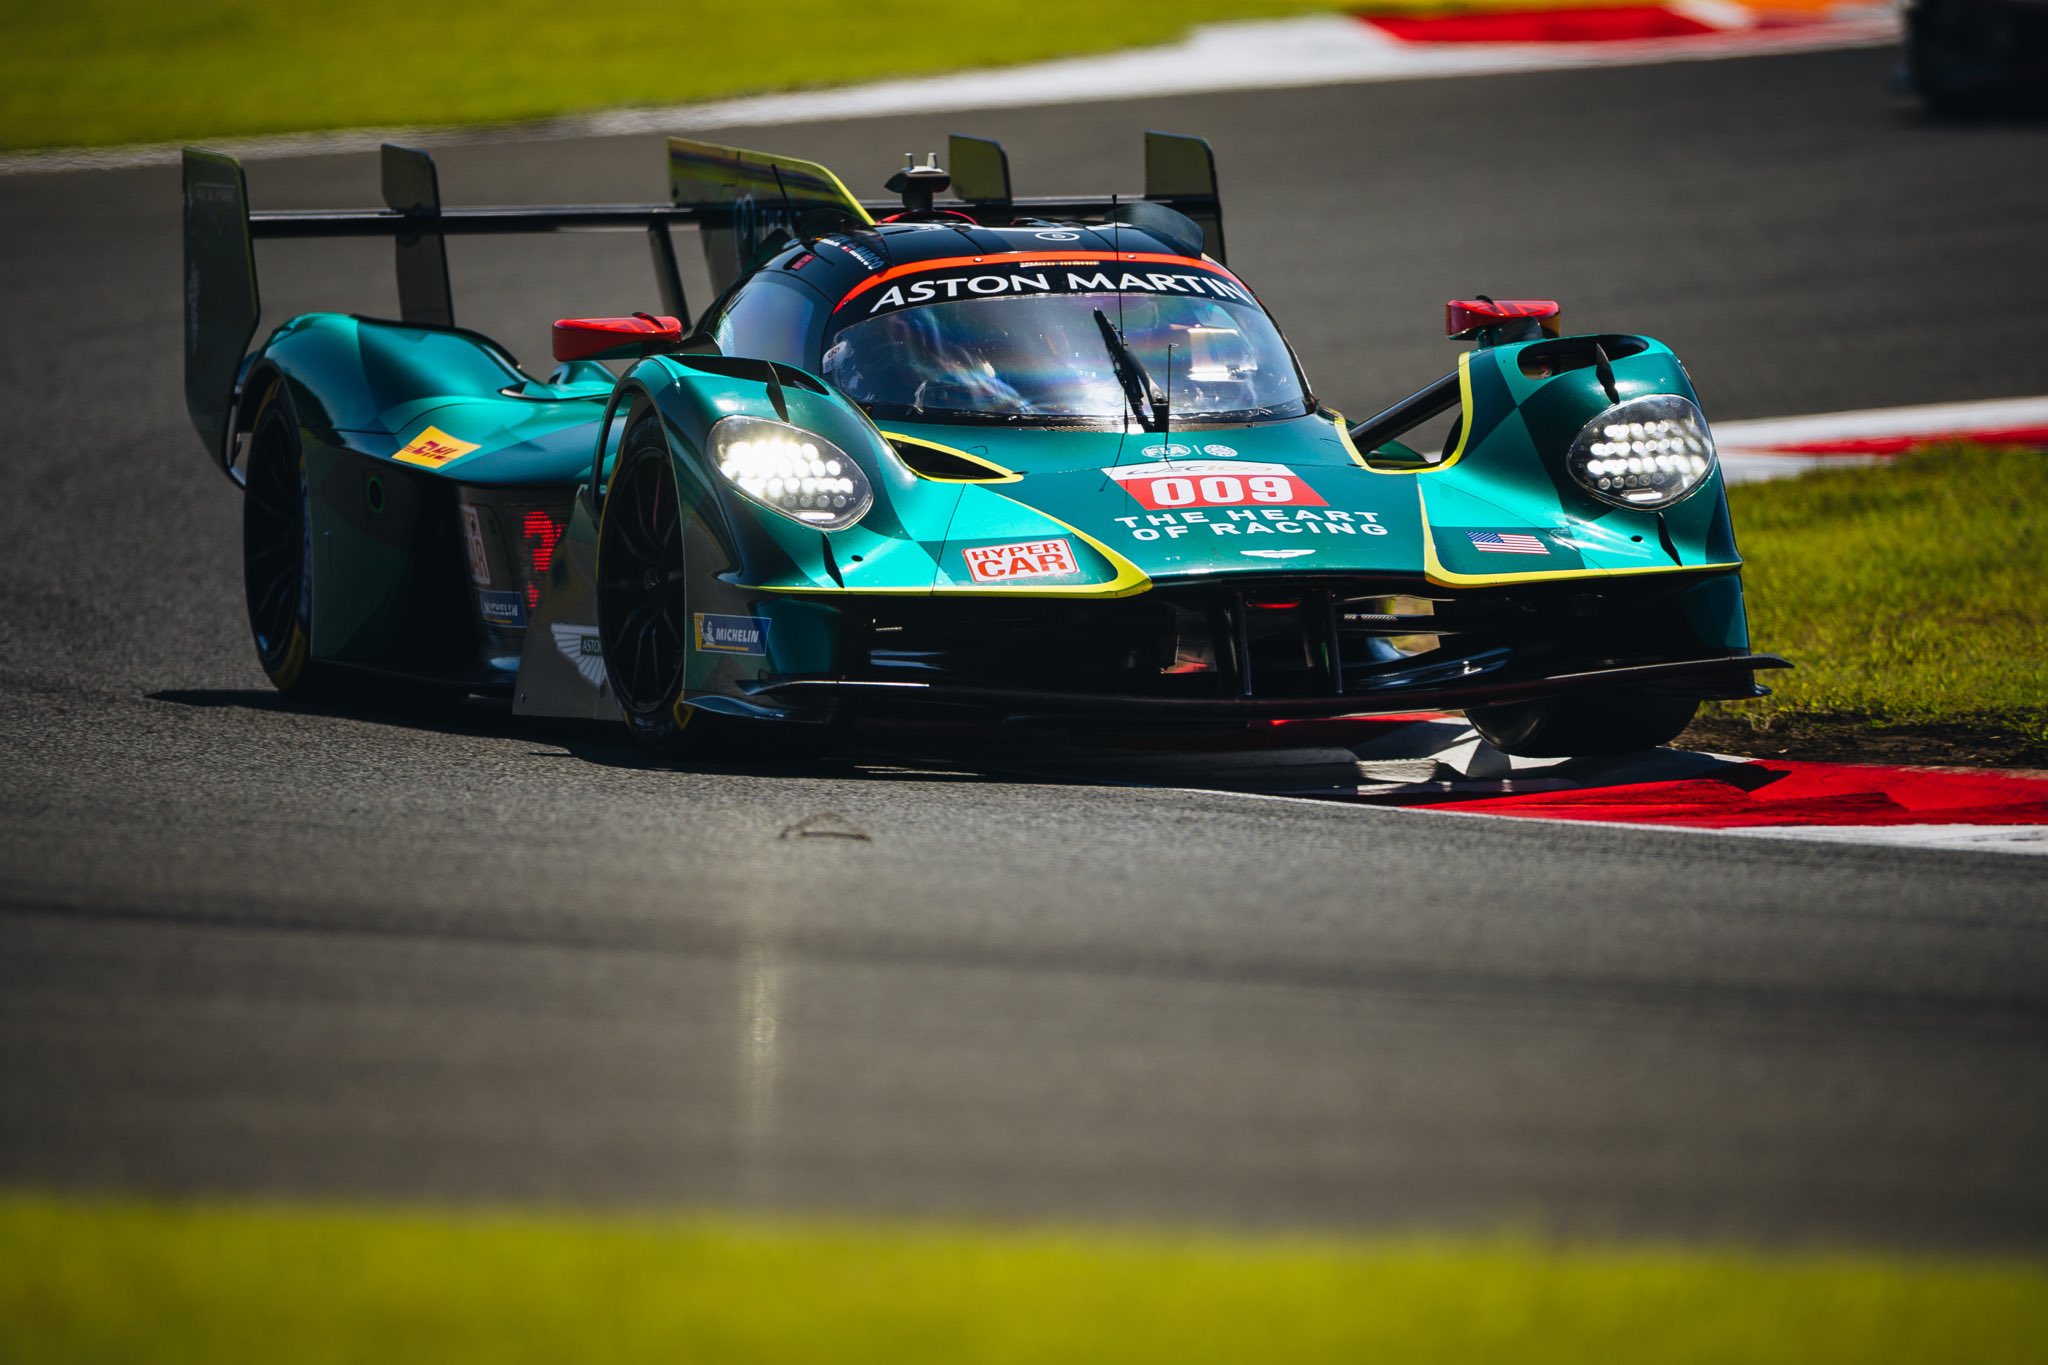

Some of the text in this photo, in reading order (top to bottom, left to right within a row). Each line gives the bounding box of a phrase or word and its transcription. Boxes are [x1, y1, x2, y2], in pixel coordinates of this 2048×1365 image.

[870, 272, 1254, 313] ASTON MARTIN
[1150, 476, 1293, 506] 009
[1114, 509, 1379, 528] THE HEART
[1132, 521, 1389, 541] OF RACING
[971, 542, 1061, 561] HYPER
[977, 553, 1069, 577] CAR
[715, 627, 760, 643] MICHELIN
